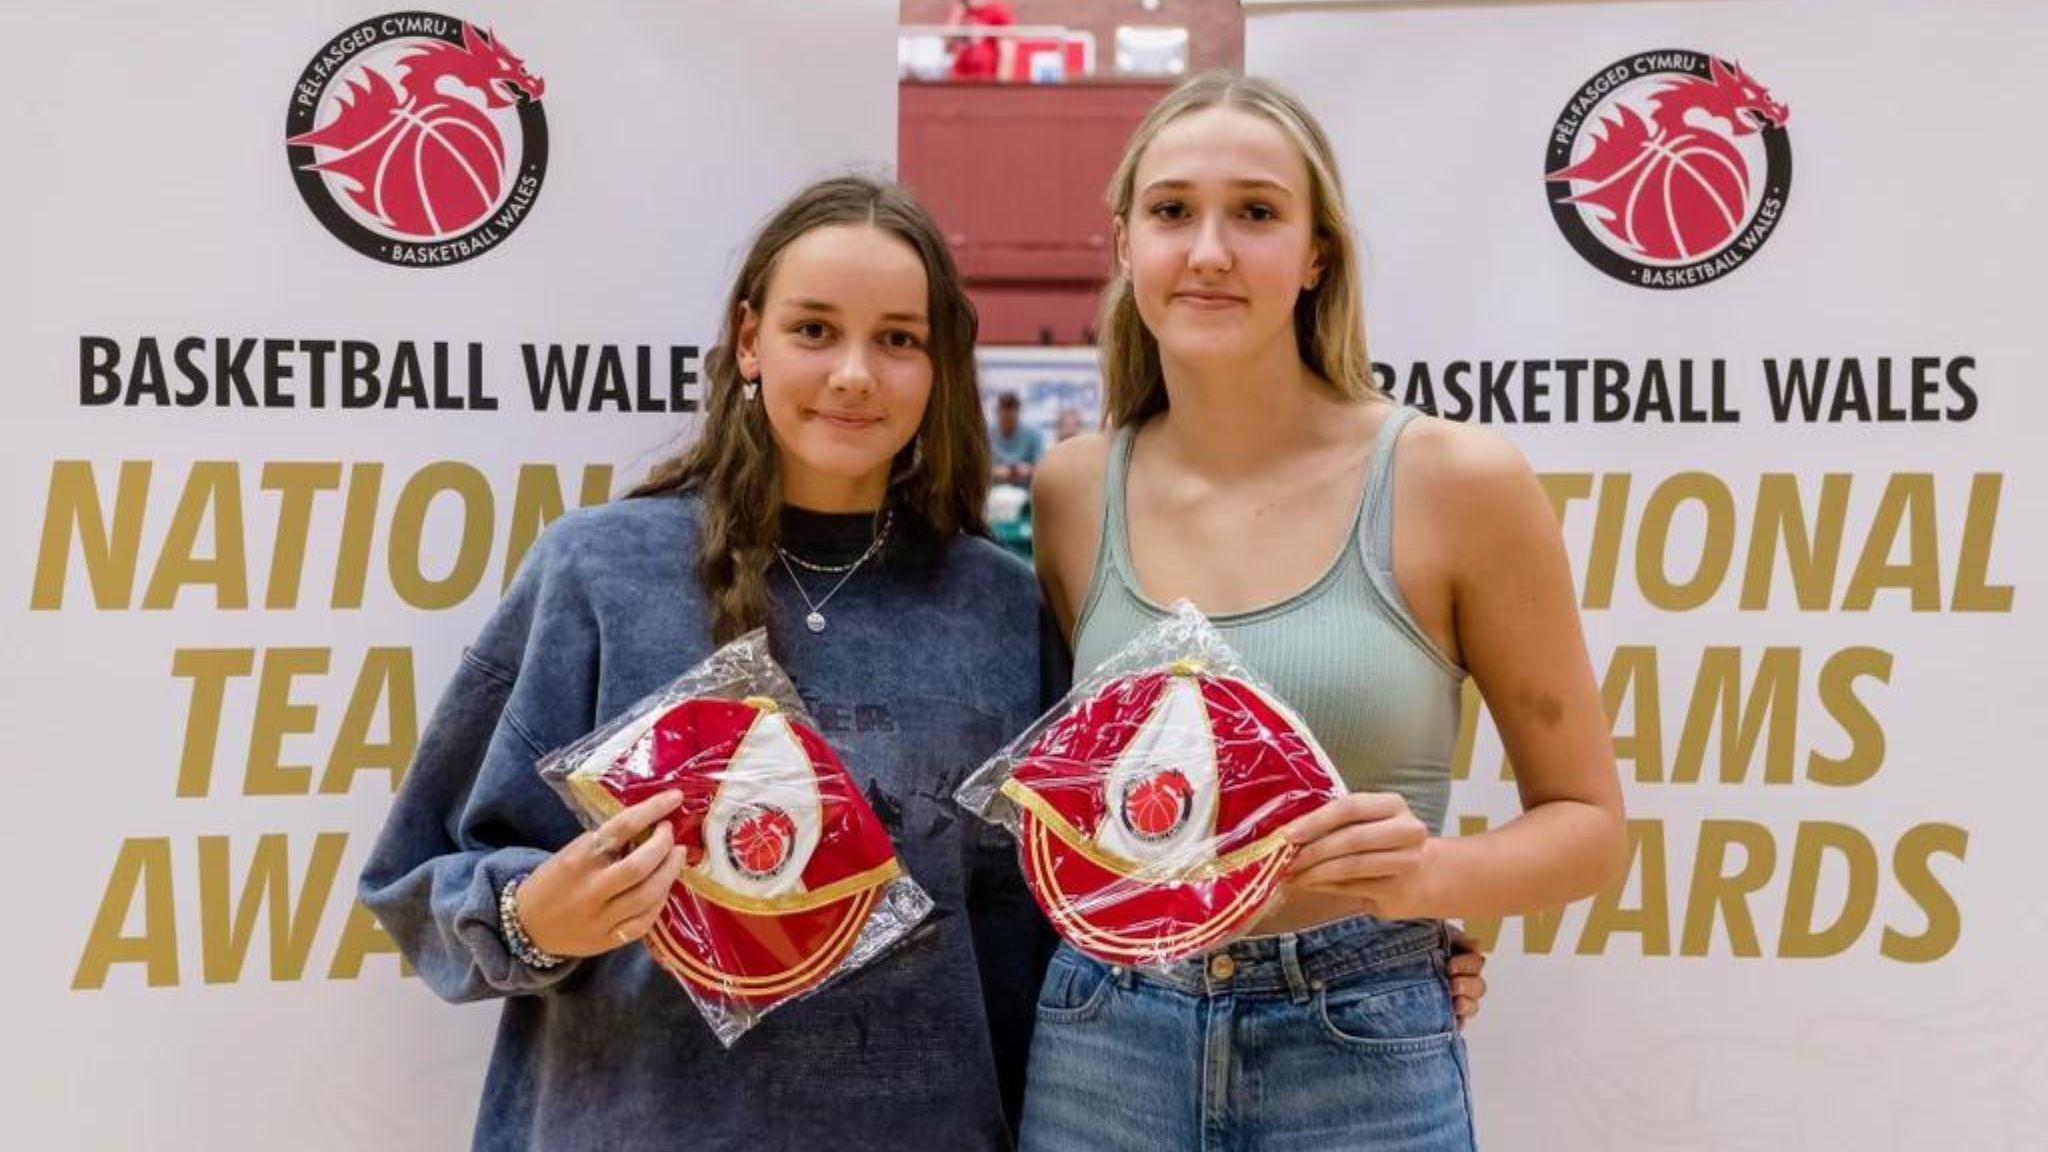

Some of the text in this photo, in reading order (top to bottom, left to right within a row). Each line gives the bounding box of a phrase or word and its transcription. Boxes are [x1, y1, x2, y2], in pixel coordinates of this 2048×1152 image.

[381, 17, 448, 37] CYMRU
[1633, 54, 1697, 73] CYMRU
[391, 174, 538, 264] BASKETBALL WALES
[1641, 198, 1781, 286] BASKETBALL WALES
[79, 335, 718, 414] BASKETBALL WALE
[1763, 356, 1979, 423] WALES
[1446, 645, 1895, 787] AMS
